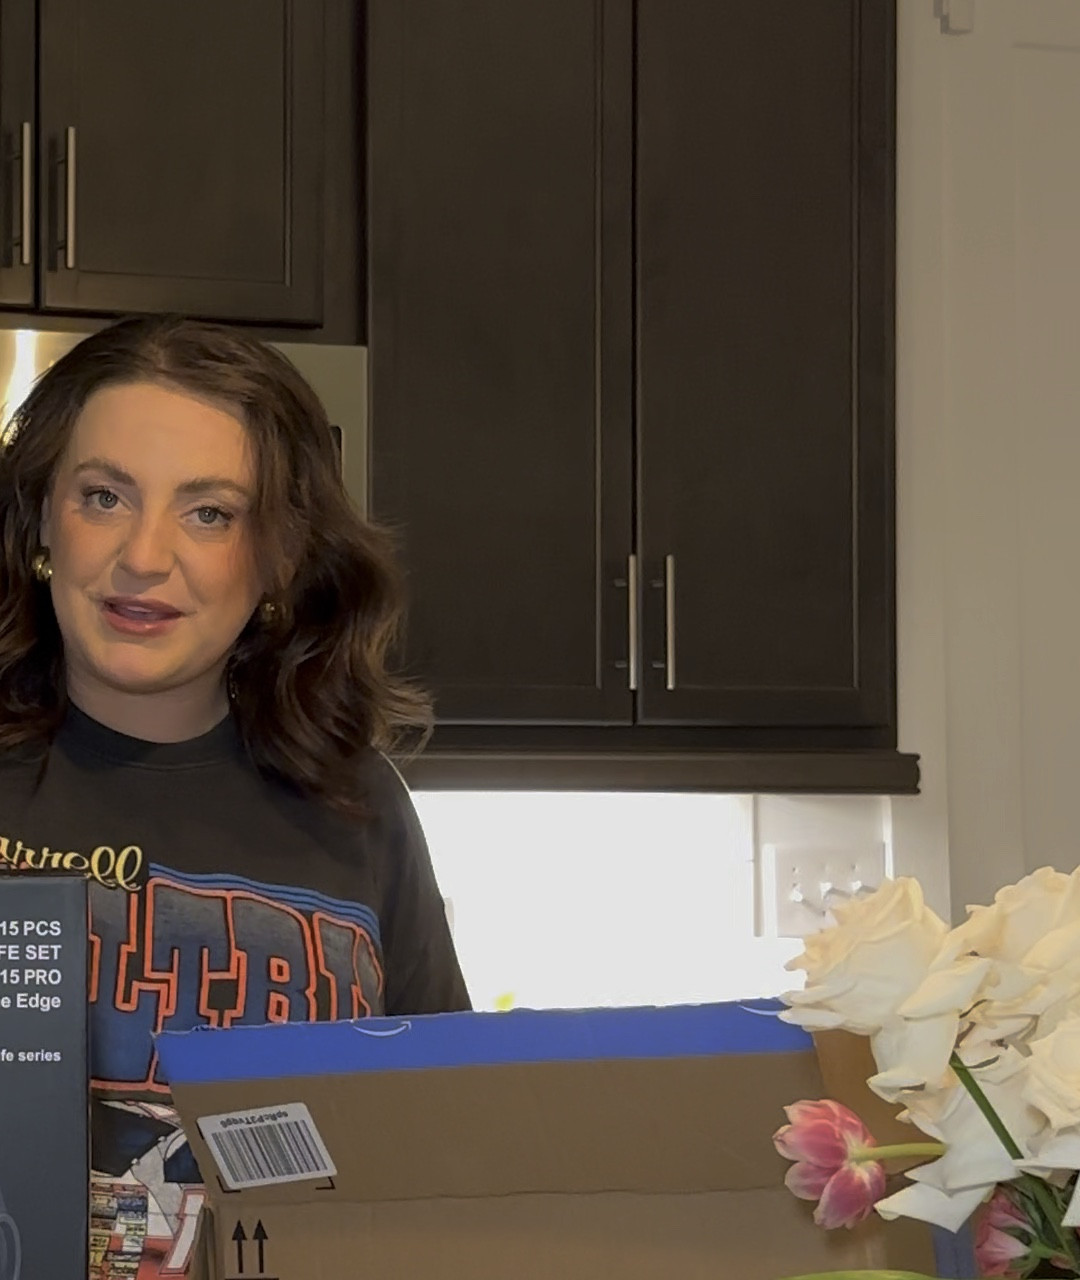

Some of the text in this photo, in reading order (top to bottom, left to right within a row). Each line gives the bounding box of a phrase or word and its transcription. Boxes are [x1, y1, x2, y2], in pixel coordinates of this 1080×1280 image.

[23, 920, 62, 936] PCS
[25, 944, 62, 960] SET
[23, 968, 62, 985] PRO
[16, 992, 62, 1012] Edge
[18, 1048, 62, 1062] series
